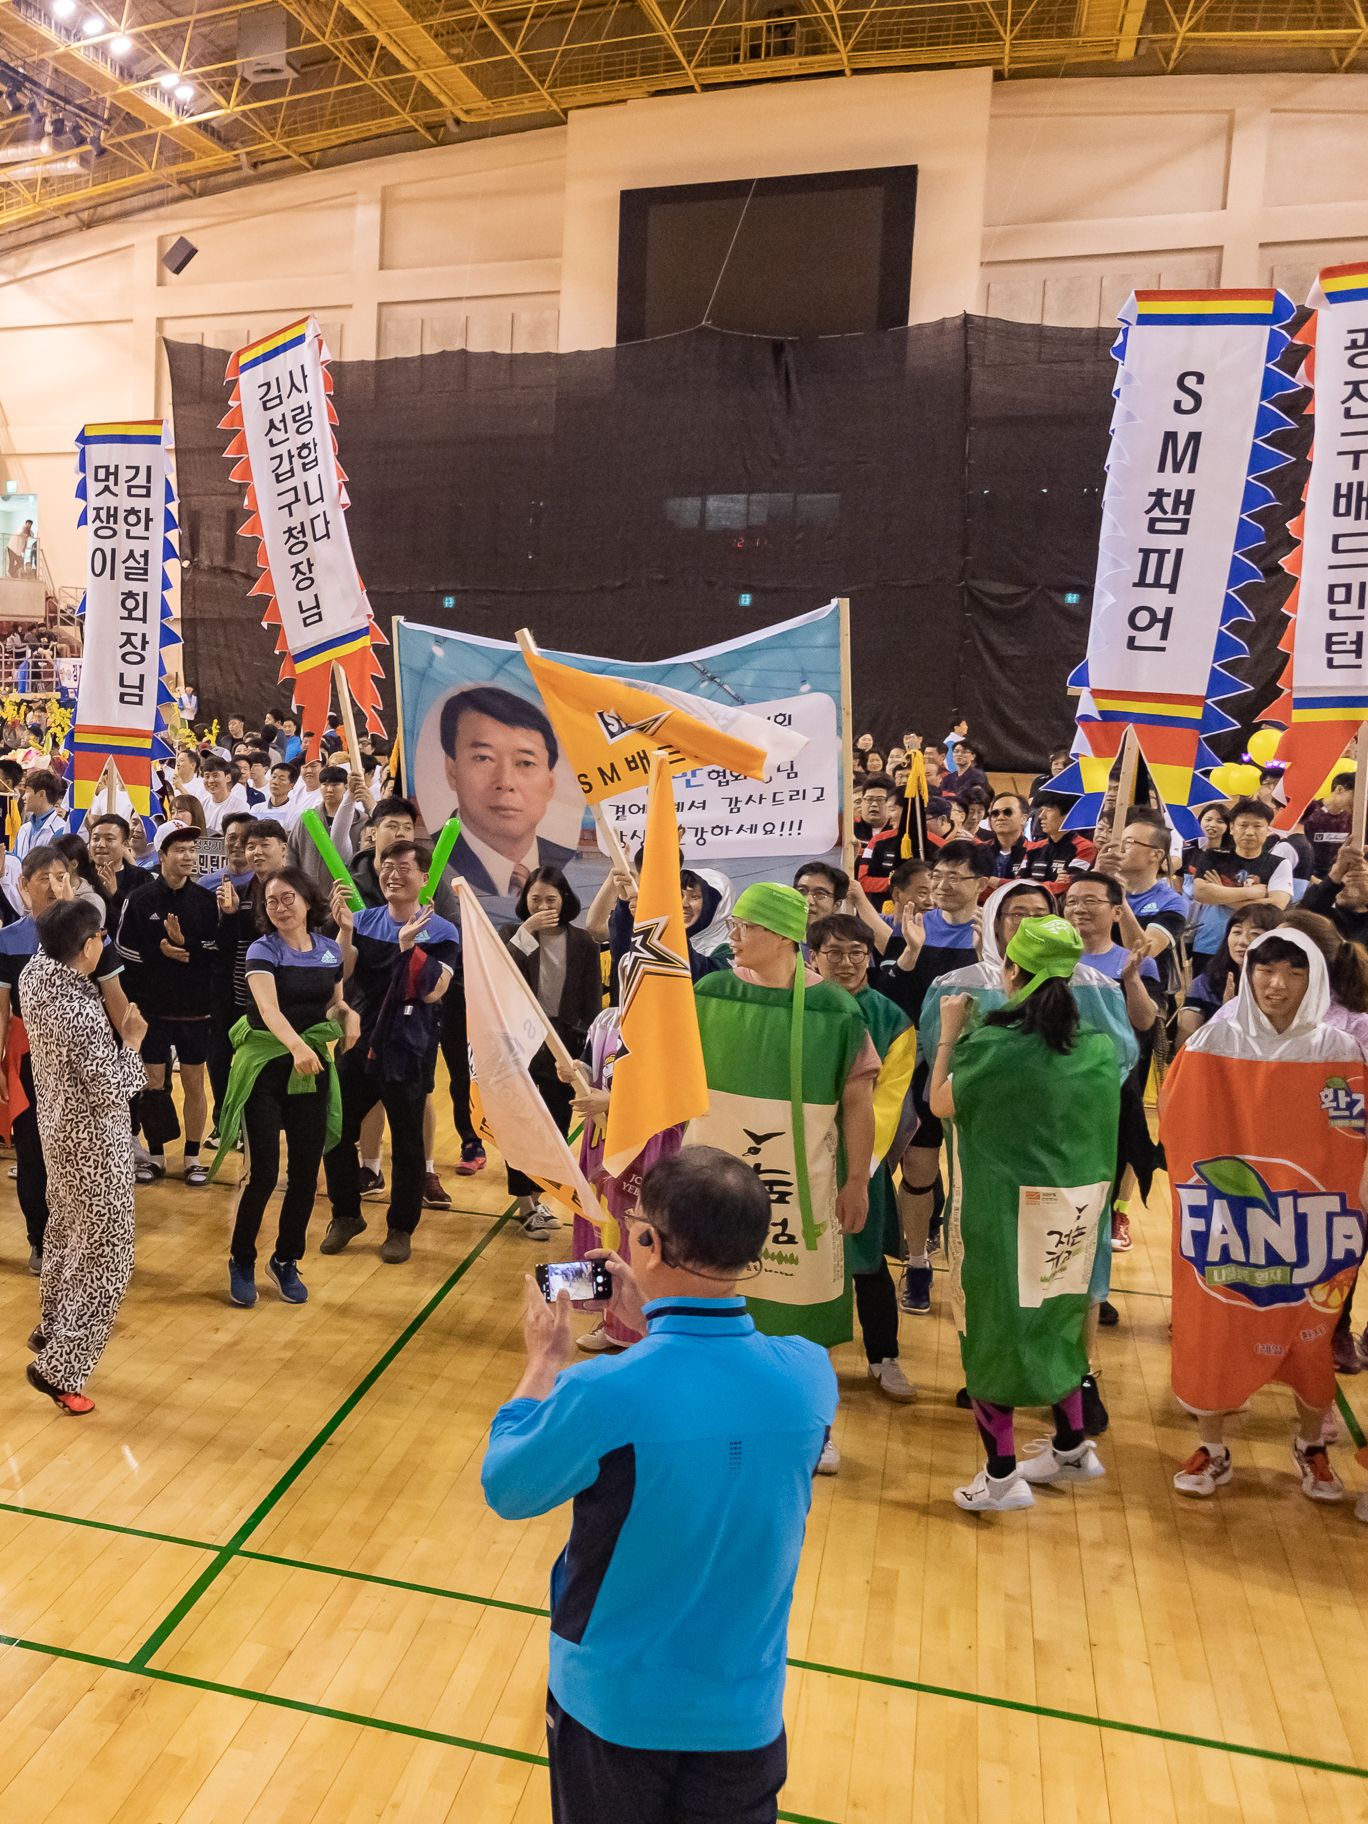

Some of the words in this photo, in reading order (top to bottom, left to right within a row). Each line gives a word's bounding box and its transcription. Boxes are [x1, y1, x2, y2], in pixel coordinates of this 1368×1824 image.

[257, 376, 323, 628] 김선갑구청장님
[286, 364, 331, 541] 사랑합니다
[90, 464, 120, 580] 멋쟁이
[118, 465, 154, 706] 김한설회장님
[679, 819, 803, 846] 강하세요!!!
[721, 786, 825, 814] 감사드리고
[1177, 1187, 1364, 1285] FANJA
